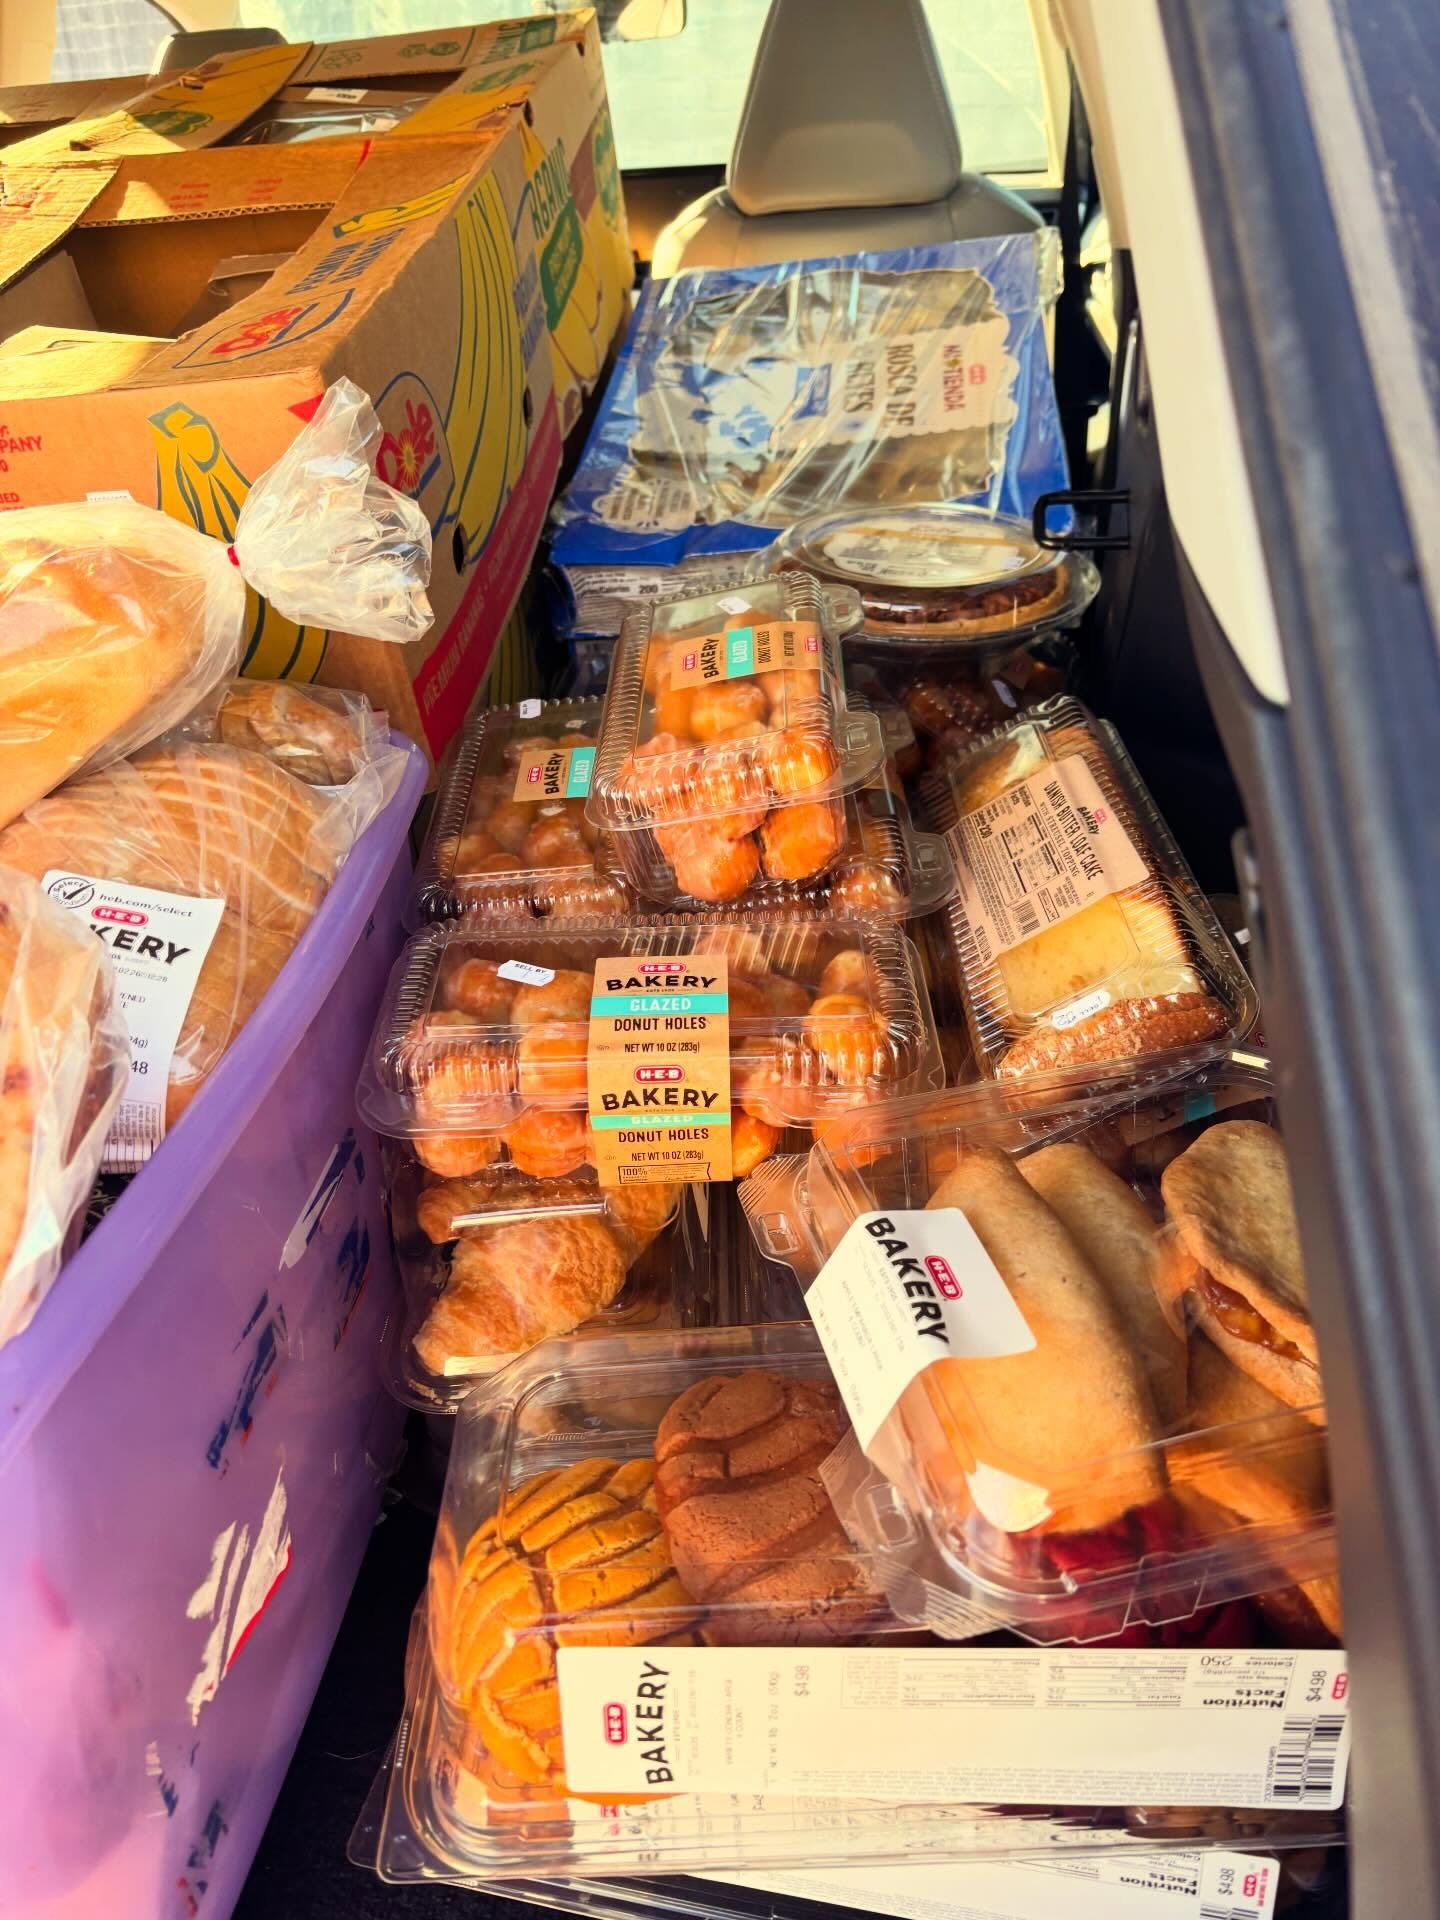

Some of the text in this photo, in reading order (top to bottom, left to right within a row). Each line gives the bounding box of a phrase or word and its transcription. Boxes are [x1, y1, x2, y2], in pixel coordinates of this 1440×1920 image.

[701, 638, 720, 679] BAKERY
[544, 753, 565, 794] BAKERY
[1077, 806, 1099, 836] BAKERY
[1044, 780, 1103, 881] DANISH BUTTER LOAF CAKE
[1046, 815, 1066, 848] STREUSEL
[1061, 847, 1080, 878] TOPPING
[89, 924, 191, 965] KERY
[606, 975, 718, 991] BAKERY
[630, 998, 692, 1012] GLAZED
[614, 1017, 707, 1032] DONUT HOLES
[624, 1041, 700, 1053] NET WT 10 OZ (283g)
[601, 1087, 719, 1111] BAKERY
[631, 1115, 693, 1125] GLAZED
[618, 1128, 709, 1143] DONUT HOLES
[631, 1149, 704, 1162] NET WT 10 OZ (283g)
[622, 1167, 648, 1177] 100%
[864, 1217, 950, 1344] BAKERY
[1200, 1655, 1233, 1666] 250
[1235, 1689, 1286, 1698] Facts
[1203, 1698, 1284, 1708] Nutrition
[635, 1661, 674, 1784] BAKERY
[1120, 1876, 1197, 1896] Nutrition
[1149, 1872, 1198, 1888] Facts
